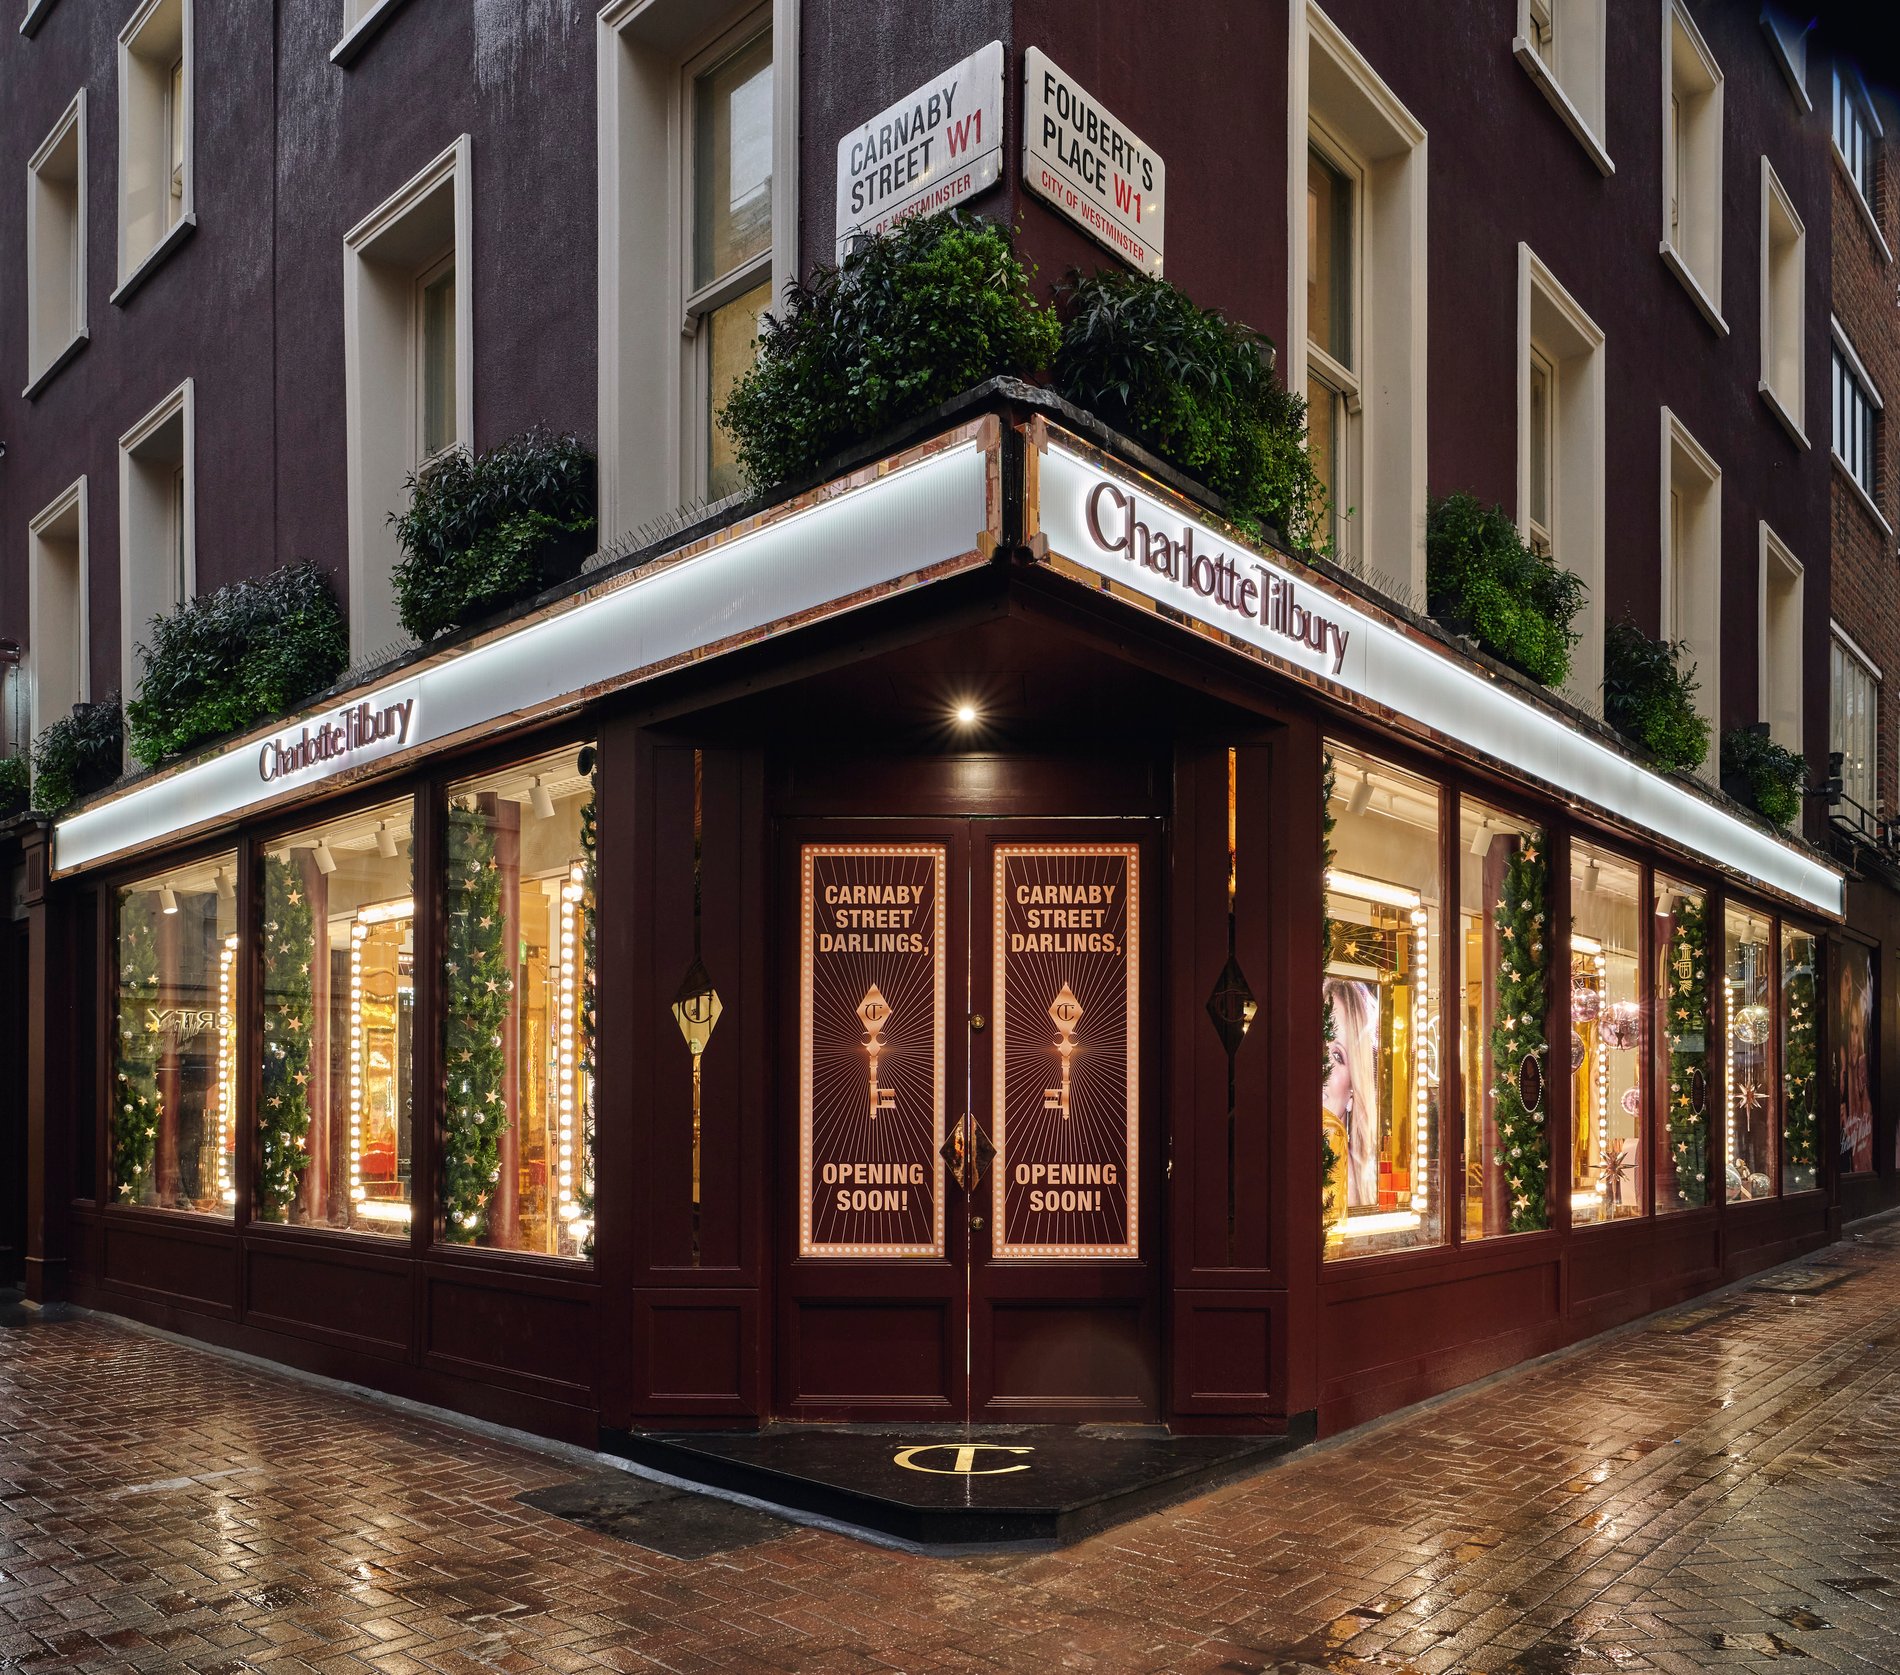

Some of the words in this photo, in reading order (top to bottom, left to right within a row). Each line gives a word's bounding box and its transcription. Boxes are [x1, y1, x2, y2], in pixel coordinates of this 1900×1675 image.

[850, 81, 958, 177] CARNABY
[1044, 70, 1154, 192] FOUBERT'S
[851, 136, 934, 215] STREET
[946, 108, 982, 159] W1
[1043, 113, 1107, 196] PLACE
[1113, 172, 1143, 225] W1
[1041, 170, 1064, 199] CITY
[1066, 189, 1079, 210] OF
[1081, 200, 1145, 263] WESTMINSTER
[825, 885, 924, 905] CARNABY
[1016, 885, 1116, 905] CARNABY
[835, 909, 913, 929] STREET
[1027, 909, 1105, 929] STREET
[820, 933, 929, 956] DARLINGS,
[1011, 933, 1121, 956] DARLINGS,
[822, 1163, 924, 1185] OPENING
[1015, 1163, 1117, 1185] OPENING
[836, 1190, 908, 1212] SOON!
[1029, 1190, 1101, 1212] SOON!
